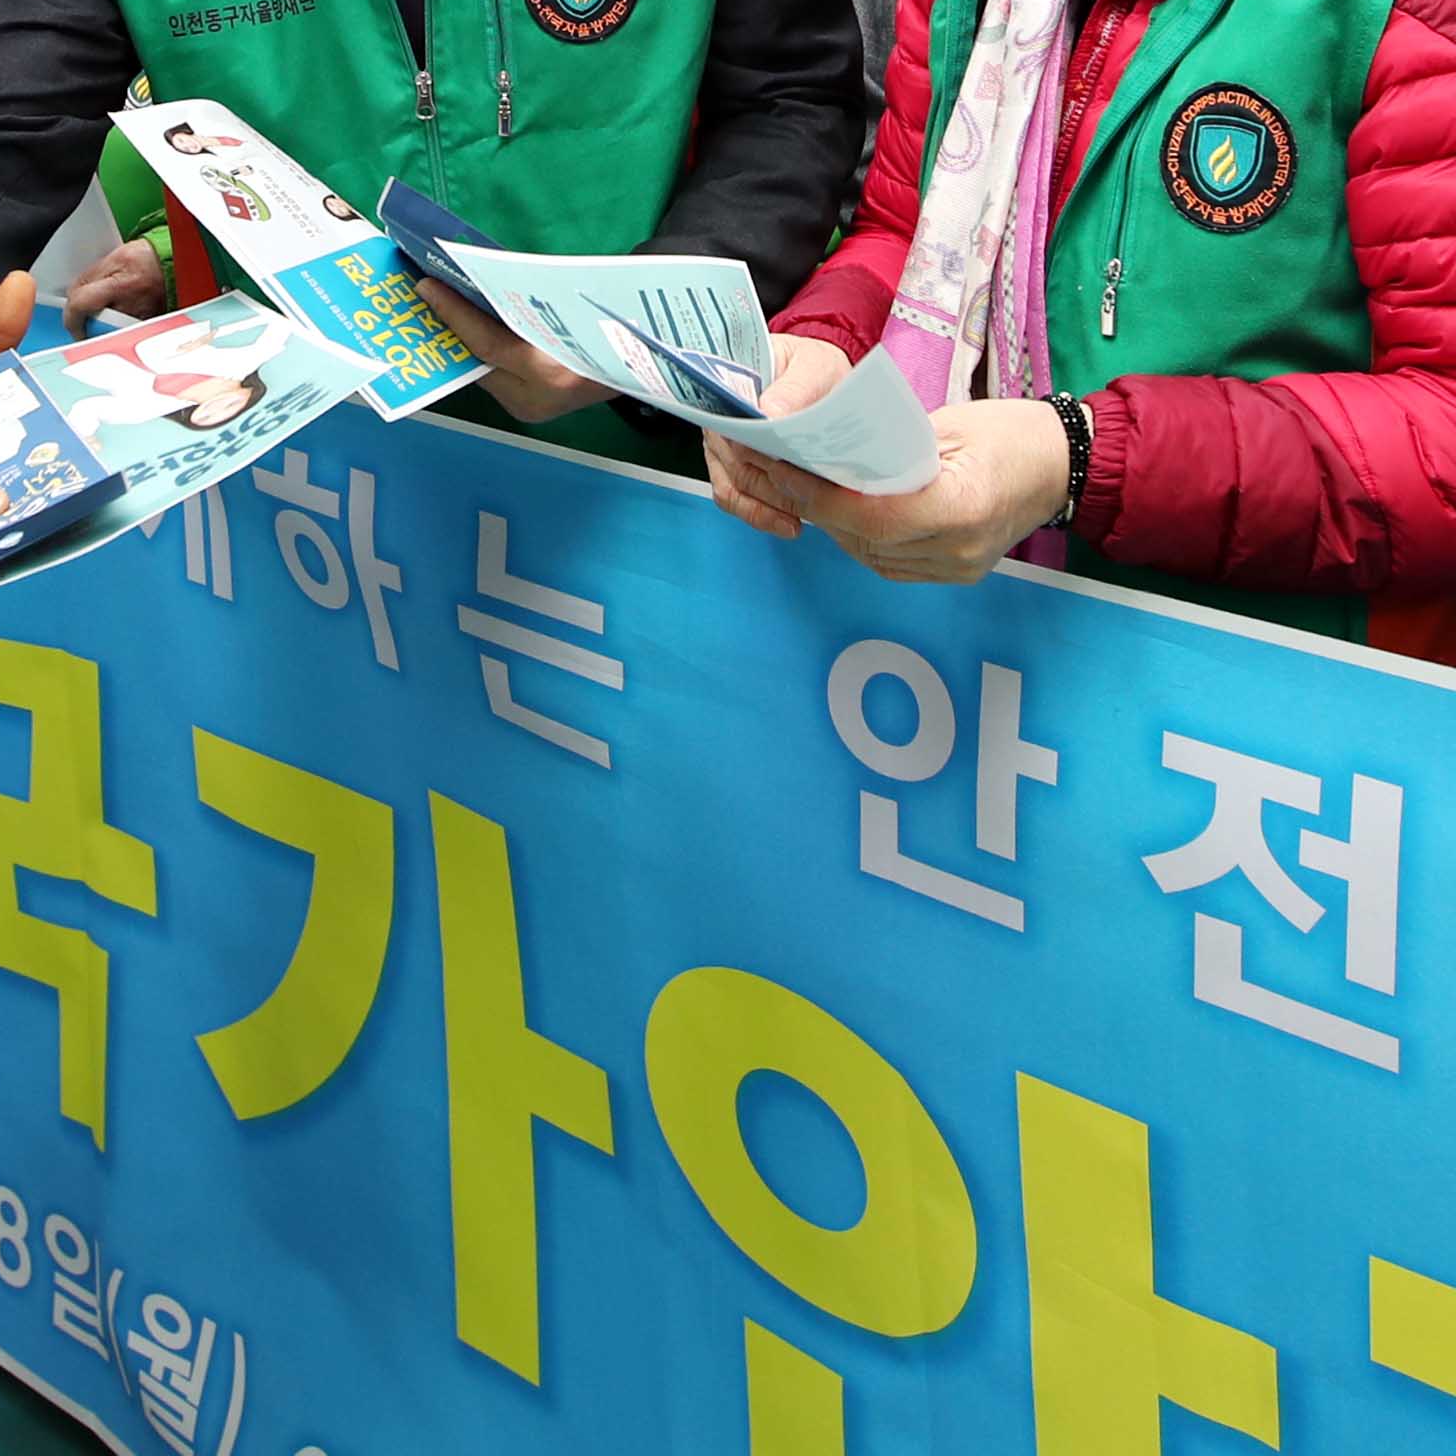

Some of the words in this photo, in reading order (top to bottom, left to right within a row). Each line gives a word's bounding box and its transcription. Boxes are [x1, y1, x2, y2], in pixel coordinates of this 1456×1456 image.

[1167, 121, 1187, 171] CITIZEN
[1181, 93, 1217, 123] CORPS
[1217, 91, 1262, 113] ACTIVE
[1269, 120, 1291, 187] DISASTER
[1172, 176, 1277, 224] 전국자율방재단
[334, 252, 447, 372] 국가안전
[352, 309, 433, 387] 2019
[173, 388, 329, 488] 2019
